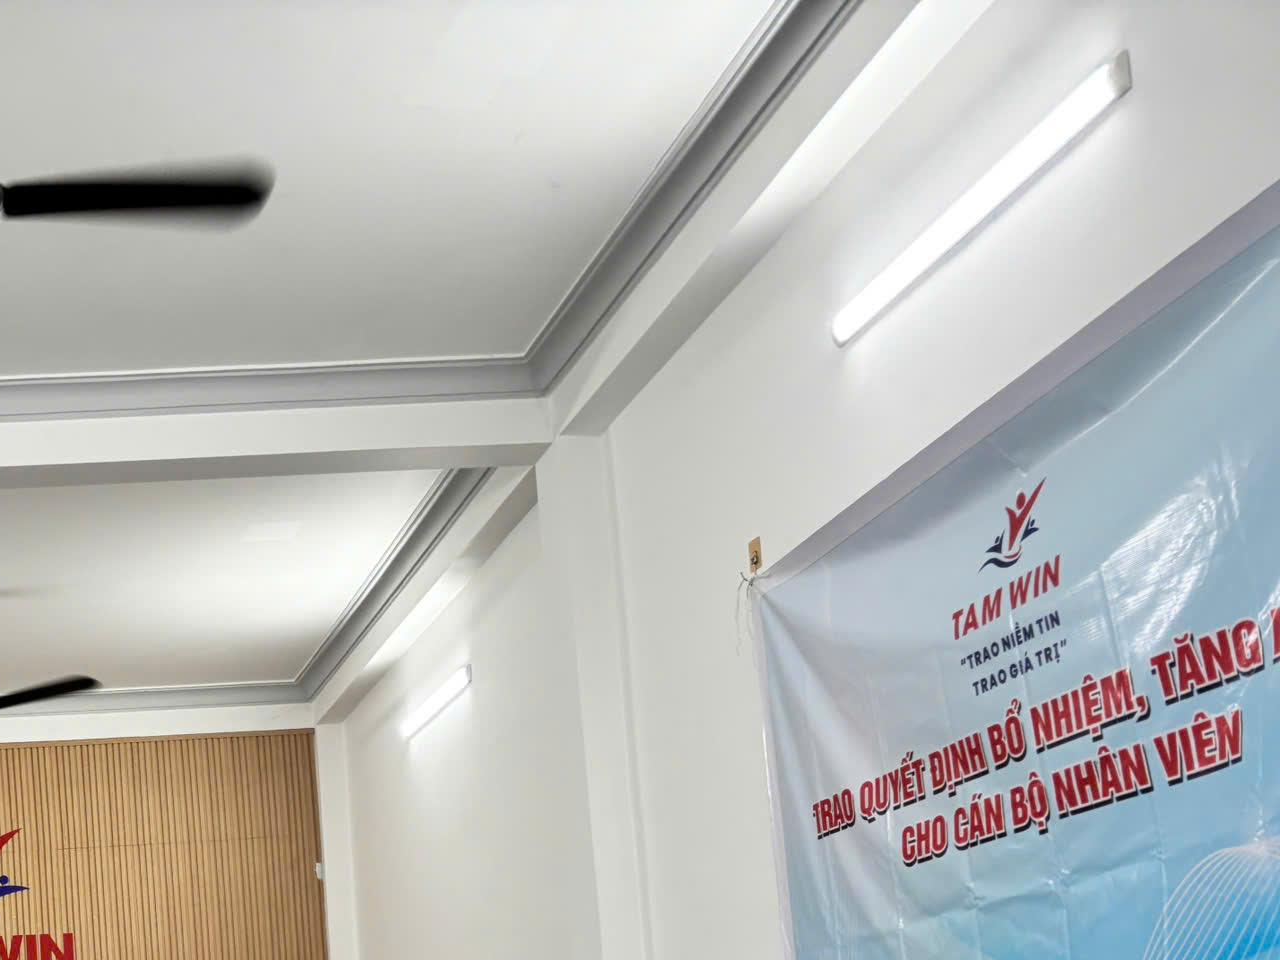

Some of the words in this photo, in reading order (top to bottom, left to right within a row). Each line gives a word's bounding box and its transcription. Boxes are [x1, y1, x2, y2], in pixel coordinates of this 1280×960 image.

[952, 587, 1002, 640] TAM
[1008, 554, 1061, 611] WIN
[1036, 610, 1061, 635] TIN
[972, 669, 1007, 697] TRAO
[1009, 651, 1034, 679] GIÁ
[813, 788, 855, 837] TRAO
[859, 752, 925, 822] QUYẾT
[928, 732, 988, 796] ĐỊNH
[987, 698, 1026, 763] BỔ
[1030, 674, 1150, 741] NHIỆM,
[1150, 619, 1264, 703] TĂNG
[902, 815, 947, 866] CHO
[954, 793, 1007, 849] CÁN
[1011, 771, 1050, 835] BỘ
[1052, 745, 1153, 818] NHÂN
[1153, 710, 1243, 785] VIÊN
